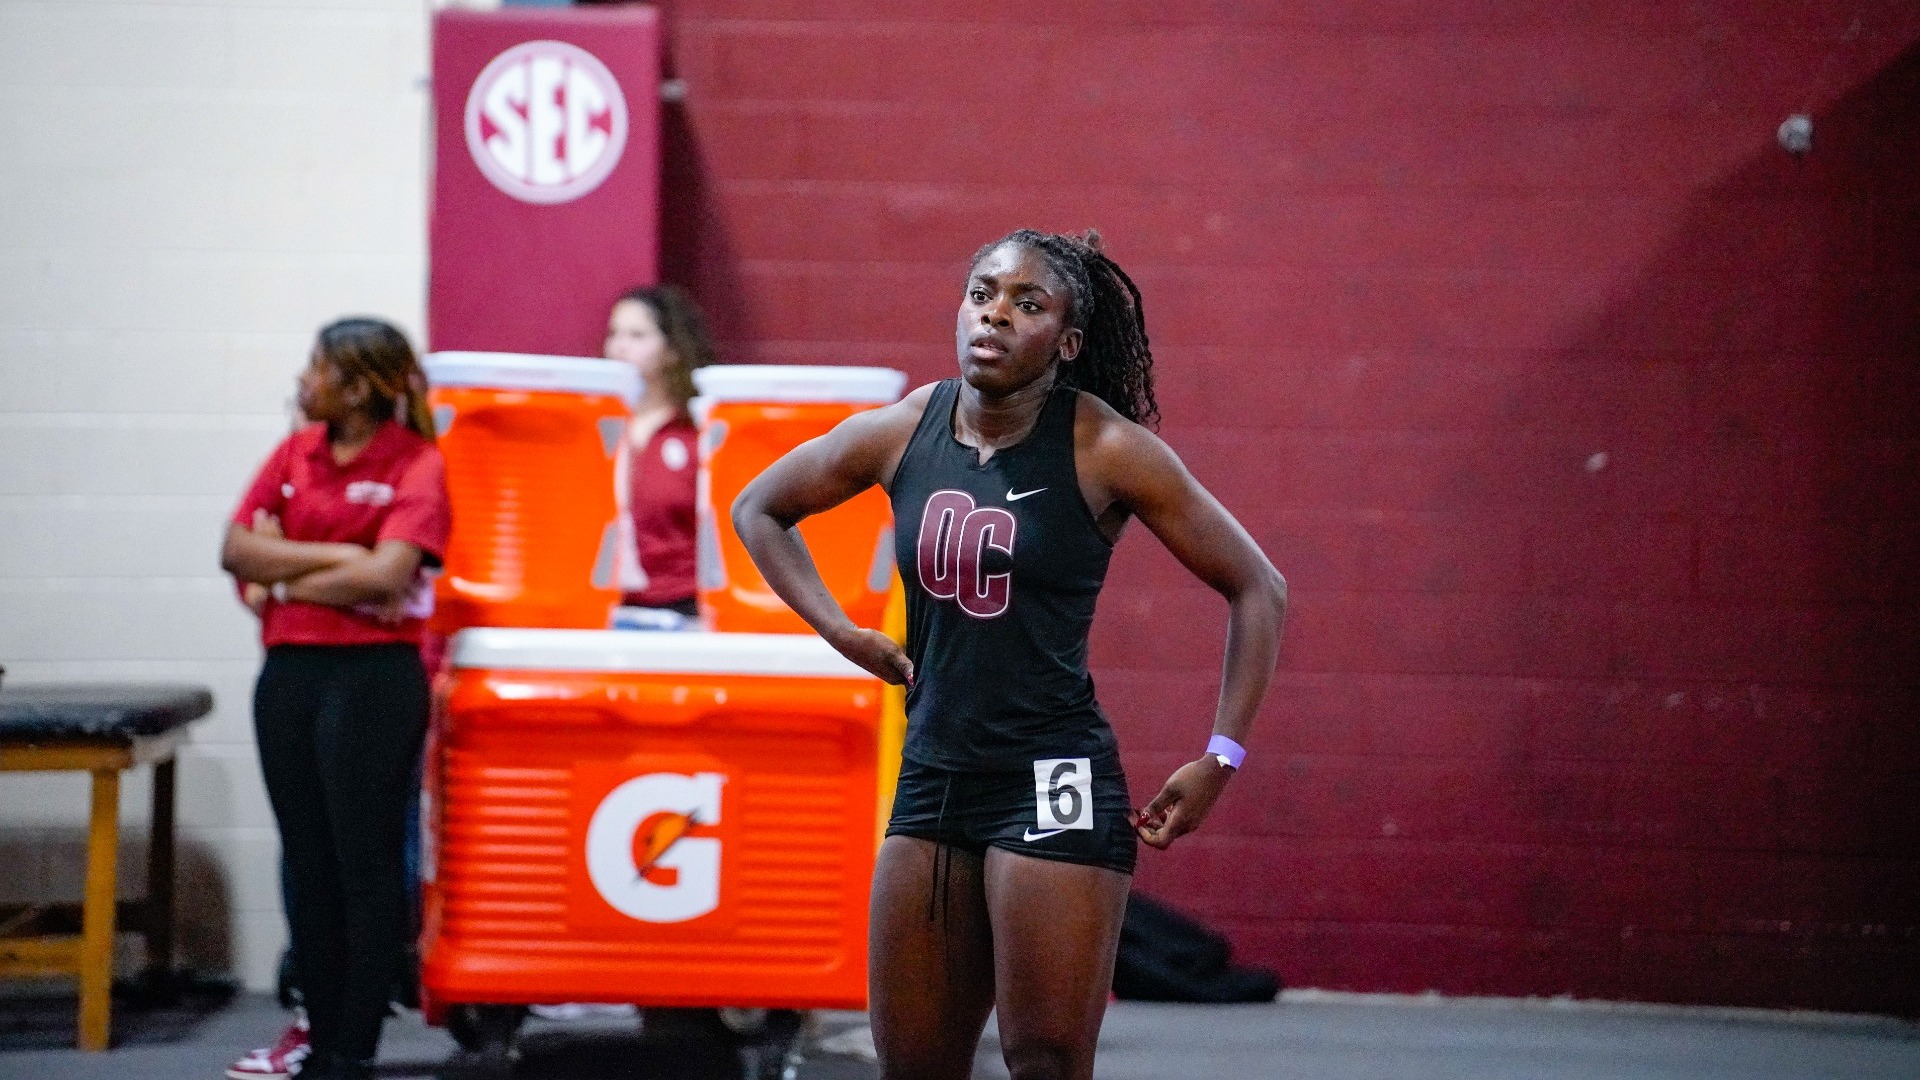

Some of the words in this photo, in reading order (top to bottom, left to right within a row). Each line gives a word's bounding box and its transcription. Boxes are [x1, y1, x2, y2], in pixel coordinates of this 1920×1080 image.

[484, 57, 610, 186] SEC
[917, 489, 1017, 619] OC
[585, 771, 729, 923] G
[1048, 761, 1083, 825] 6
